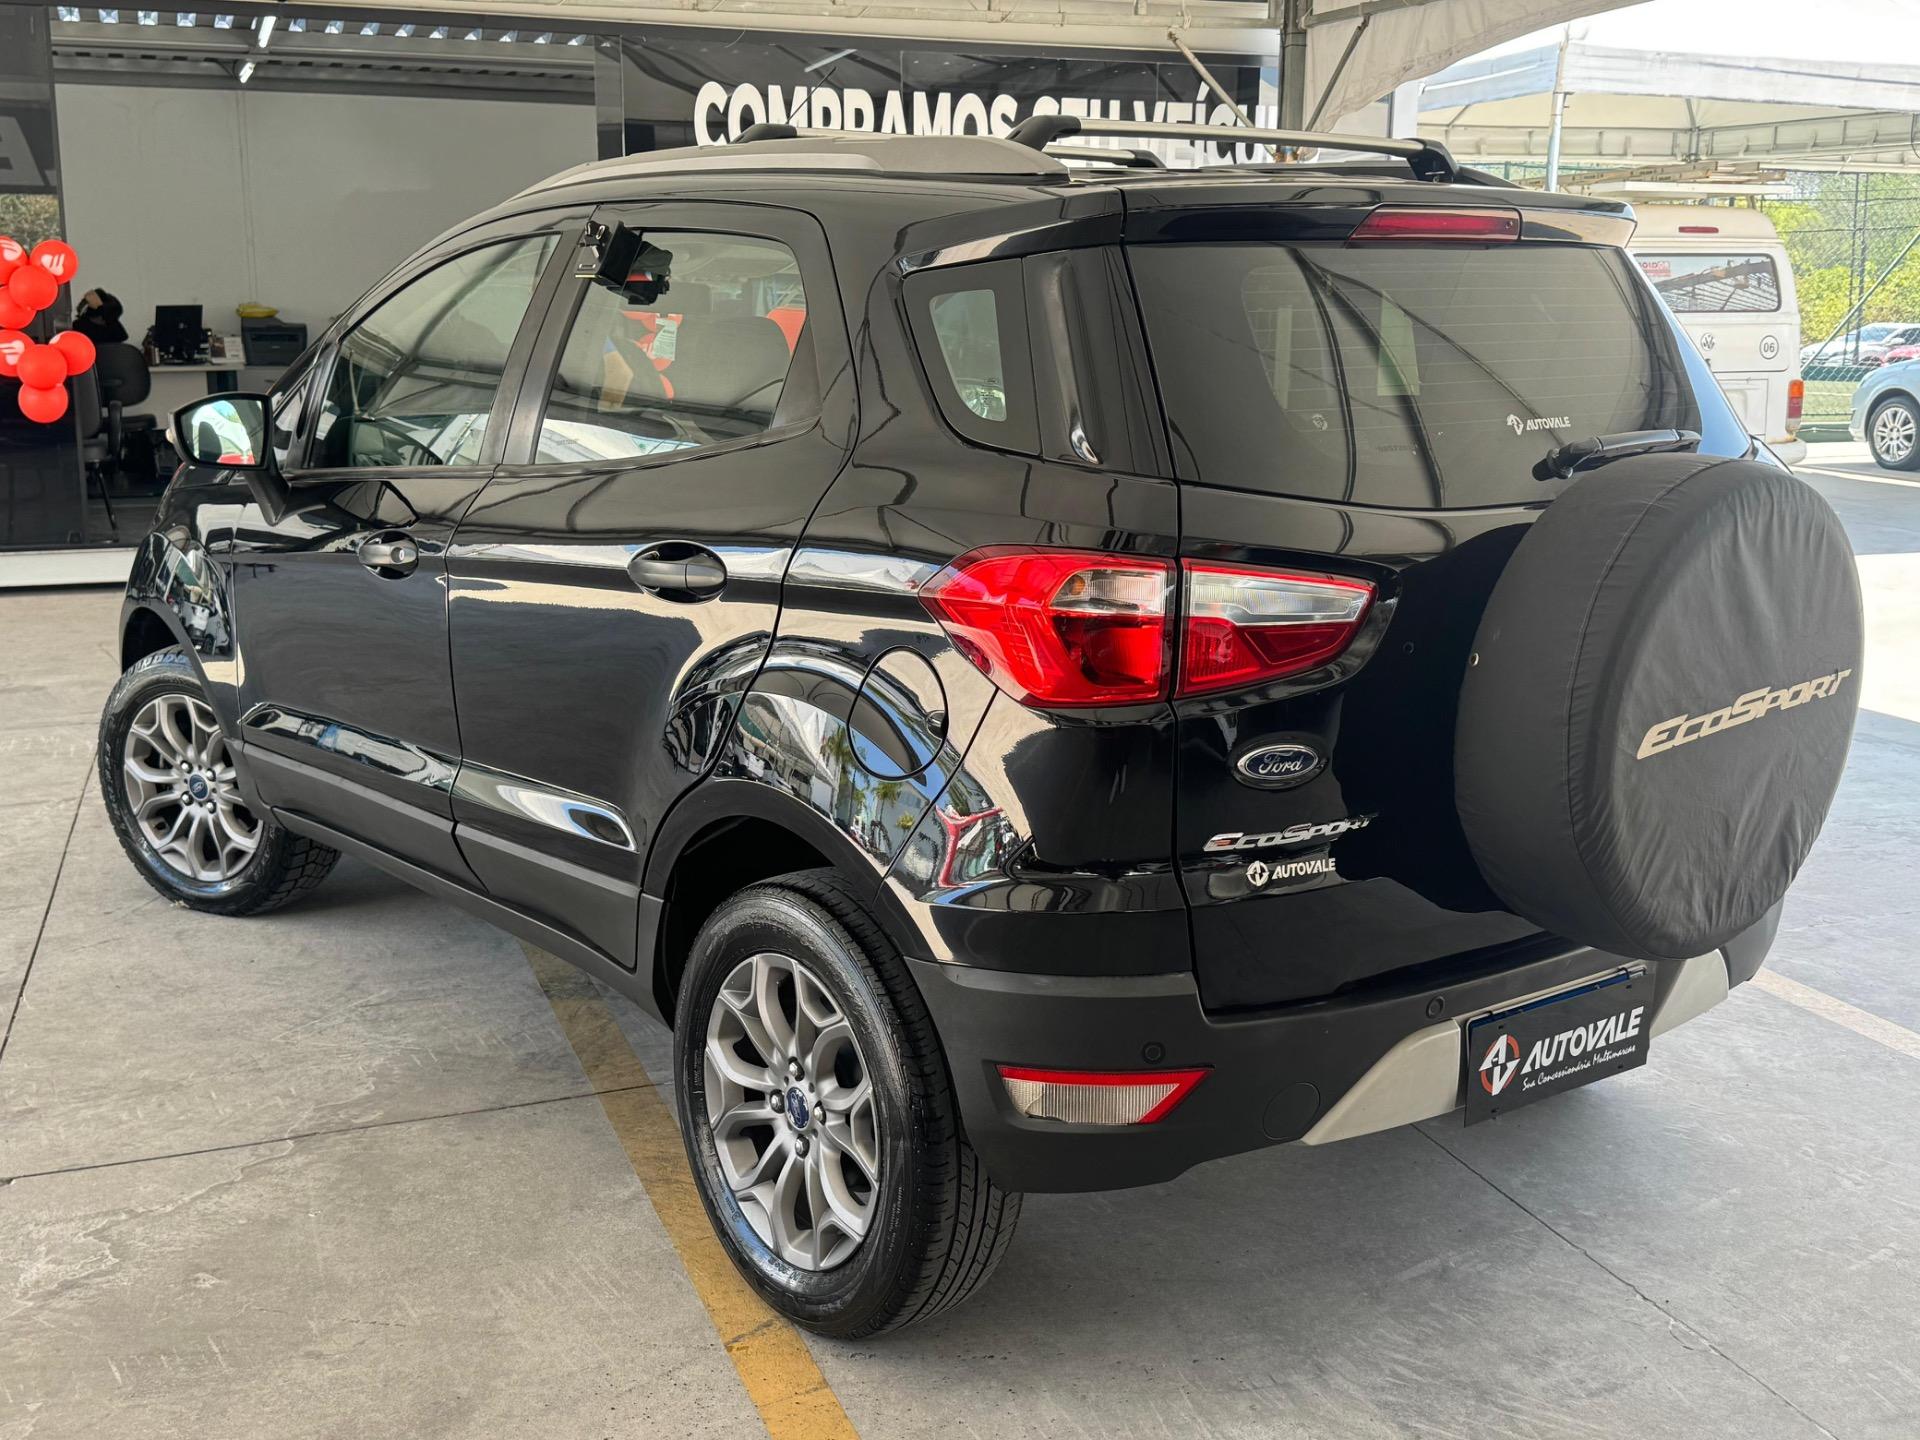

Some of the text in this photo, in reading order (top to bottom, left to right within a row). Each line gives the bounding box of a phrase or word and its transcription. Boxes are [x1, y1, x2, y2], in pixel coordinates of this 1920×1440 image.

[1763, 342, 1775, 353] 06
[1526, 416, 1571, 431] AUTOVALE
[1258, 752, 1303, 774] Ford
[1271, 858, 1336, 880] AUTOVALE
[1520, 1006, 1644, 1075] AUTOVALE
